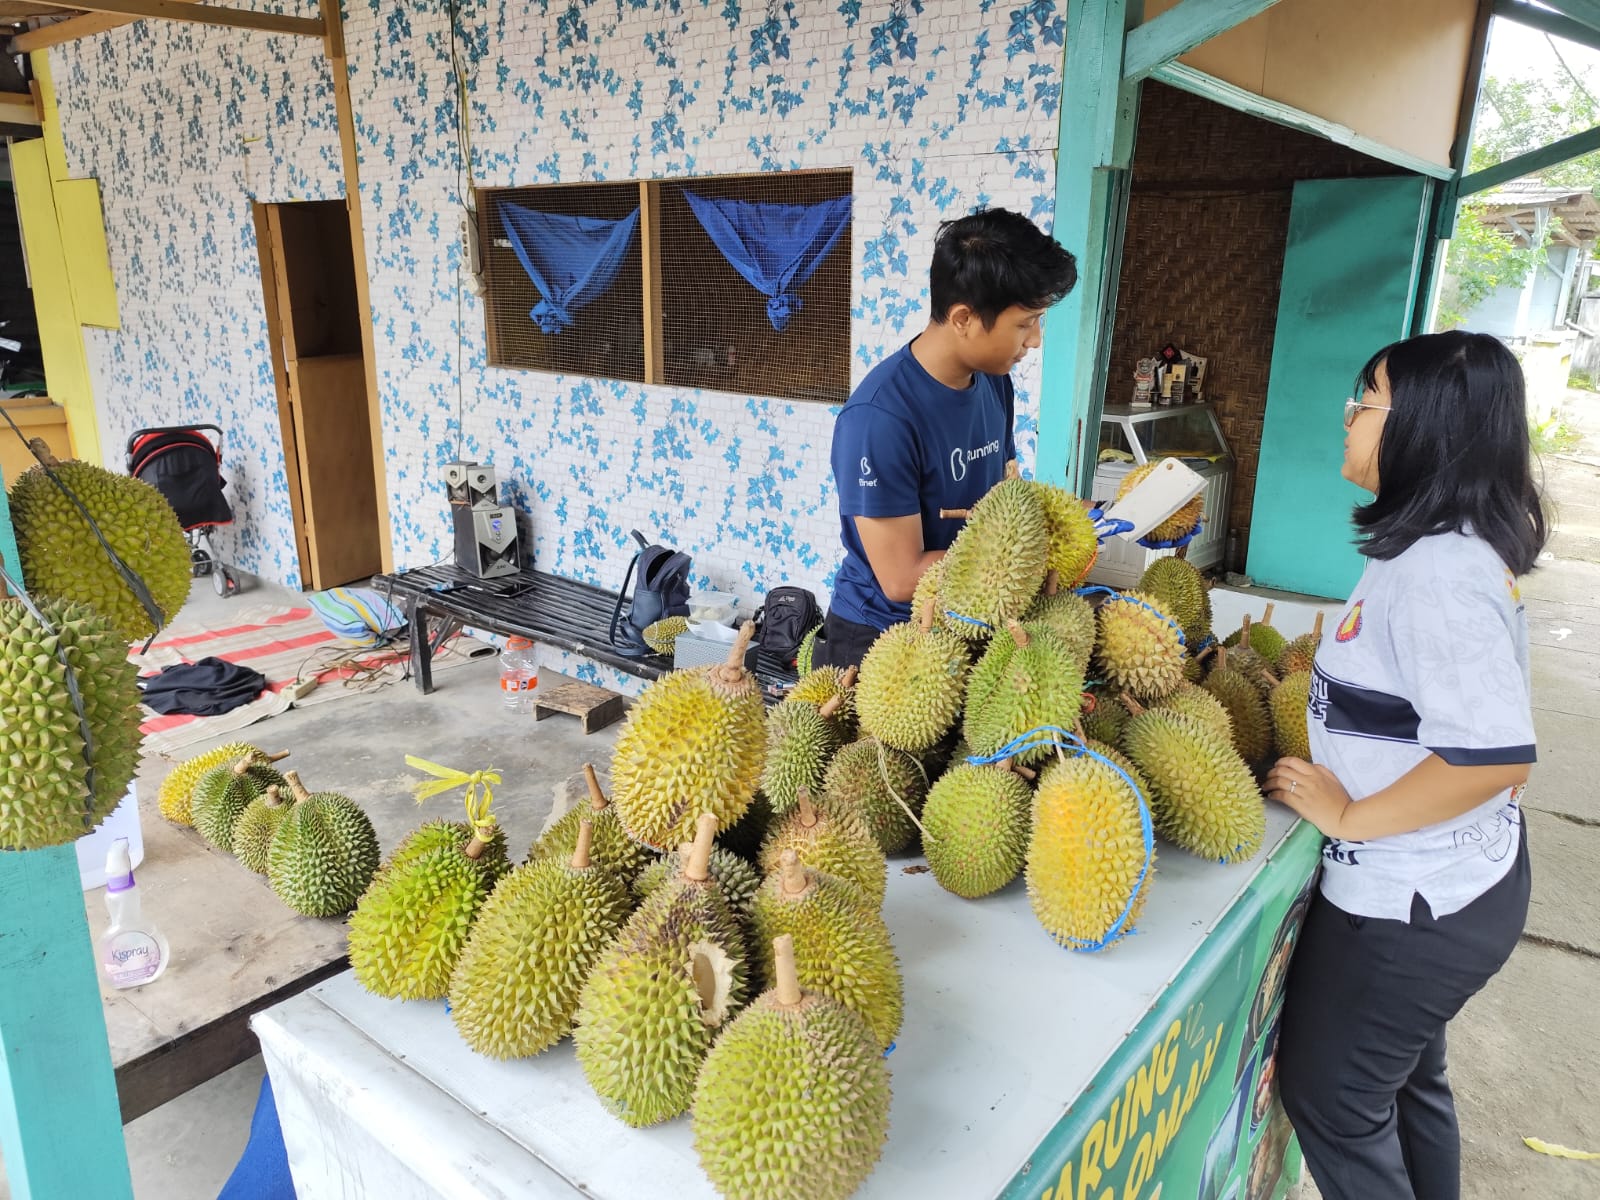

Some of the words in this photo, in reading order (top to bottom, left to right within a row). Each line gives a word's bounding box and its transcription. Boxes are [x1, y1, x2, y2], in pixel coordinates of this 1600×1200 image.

[966, 439, 1000, 464] Running
[111, 945, 149, 962] Kispray
[1041, 1018, 1182, 1200] ARUNG
